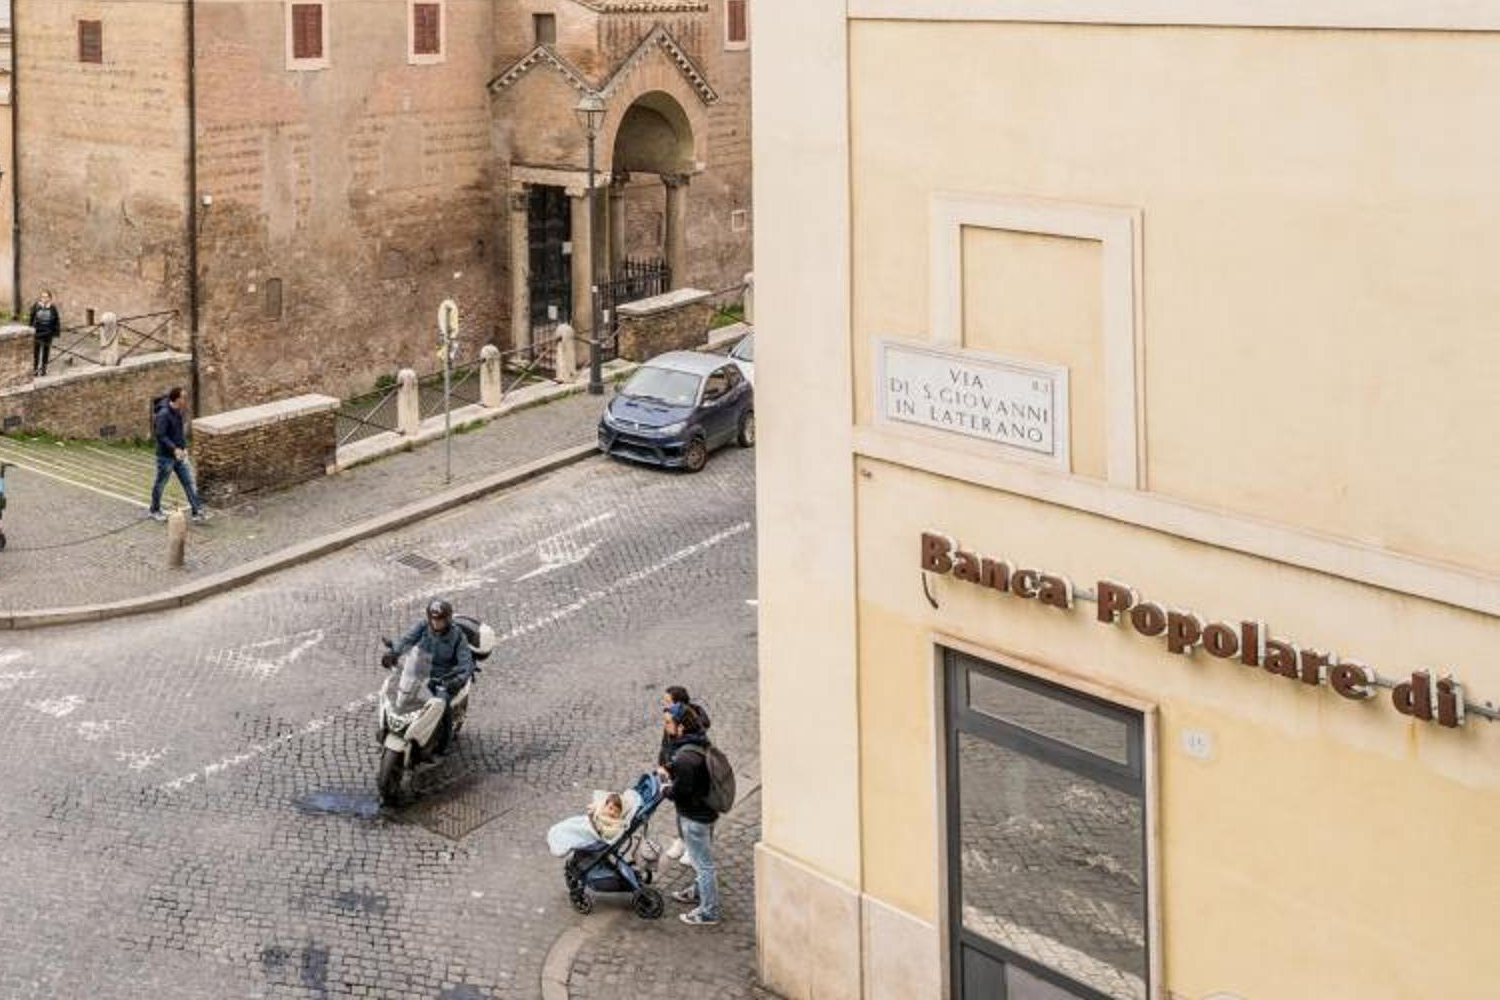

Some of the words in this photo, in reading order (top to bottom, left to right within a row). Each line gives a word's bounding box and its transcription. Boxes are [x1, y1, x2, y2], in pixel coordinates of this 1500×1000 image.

[890, 376, 909, 395] DI
[949, 368, 984, 389] VIA
[895, 399, 915, 415] IN
[930, 406, 1044, 443] LATERANO
[921, 531, 1071, 610] Banca
[1097, 579, 1376, 700] Popolare
[1392, 671, 1464, 728] di
